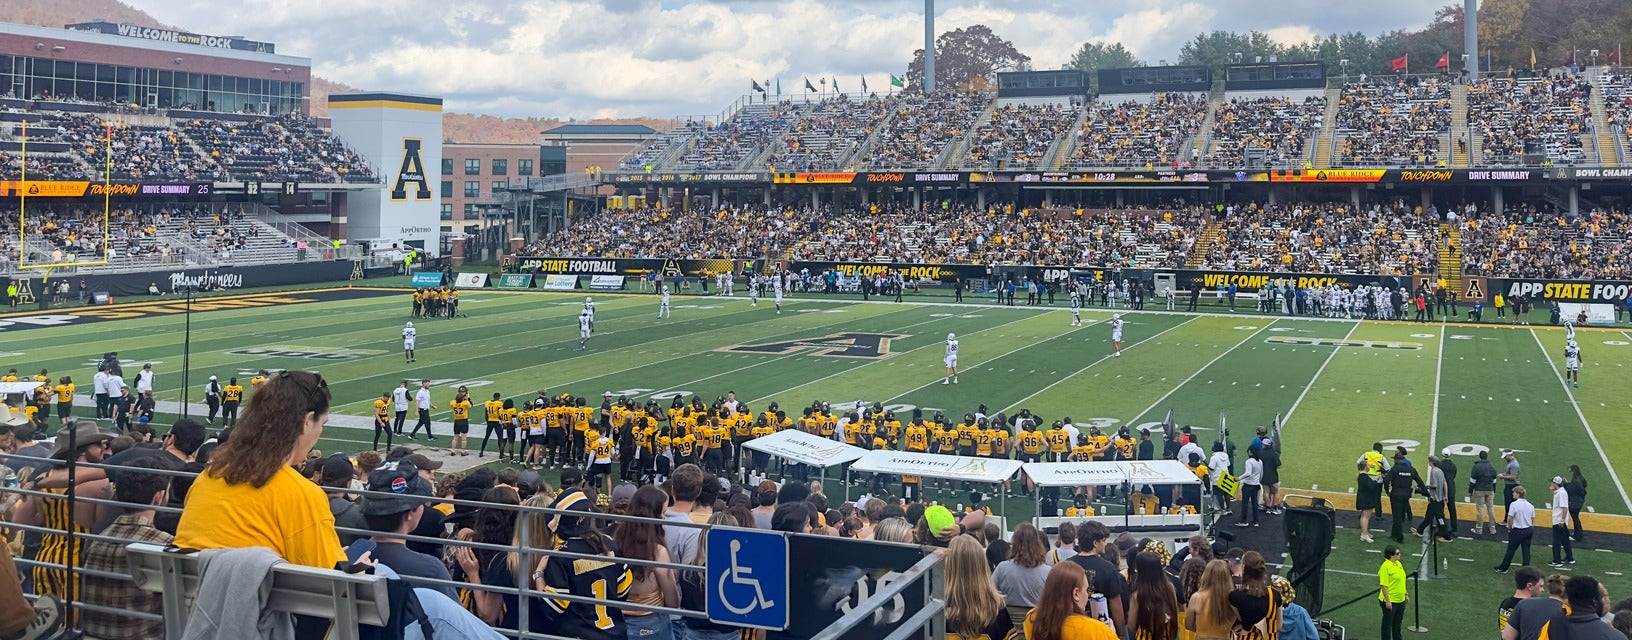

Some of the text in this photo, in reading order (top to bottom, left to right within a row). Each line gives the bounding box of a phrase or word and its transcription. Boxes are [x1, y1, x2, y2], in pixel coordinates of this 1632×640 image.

[118, 24, 179, 42] WELCOME
[188, 36, 200, 44] THE
[200, 37, 232, 48] ROCK
[390, 136, 432, 202] A
[867, 174, 905, 183] TOUCHDOWN
[1401, 170, 1454, 181] TOUCHDOWN
[1469, 171, 1490, 180] DRIVE
[1492, 171, 1530, 180] SUMMARY
[90, 183, 140, 196] TOUCHDOWN
[143, 186, 160, 194] DRIVE
[161, 186, 190, 194] SUMMARY
[198, 185, 208, 194] 25
[542, 260, 568, 272] STATE
[569, 261, 616, 272] FOOTBALL
[910, 267, 940, 279] ROCK
[1204, 274, 1269, 288] WELCOME
[1298, 277, 1337, 289] ROCK
[1466, 279, 1484, 299] A
[1508, 282, 1632, 300] APP STATE FOO
[575, 413, 585, 421] 78
[735, 420, 746, 429] 42
[823, 422, 834, 430] 40
[635, 433, 644, 442] 22
[712, 435, 720, 444] 18
[911, 434, 922, 442] 49
[960, 431, 972, 440] 95
[980, 436, 988, 444] 12
[1052, 435, 1064, 444] 45
[941, 437, 952, 445] 93
[1024, 437, 1036, 447] 96
[598, 446, 609, 455] 84
[1124, 444, 1135, 454] 27
[1381, 439, 1490, 456] 20
[591, 579, 615, 630] 1
